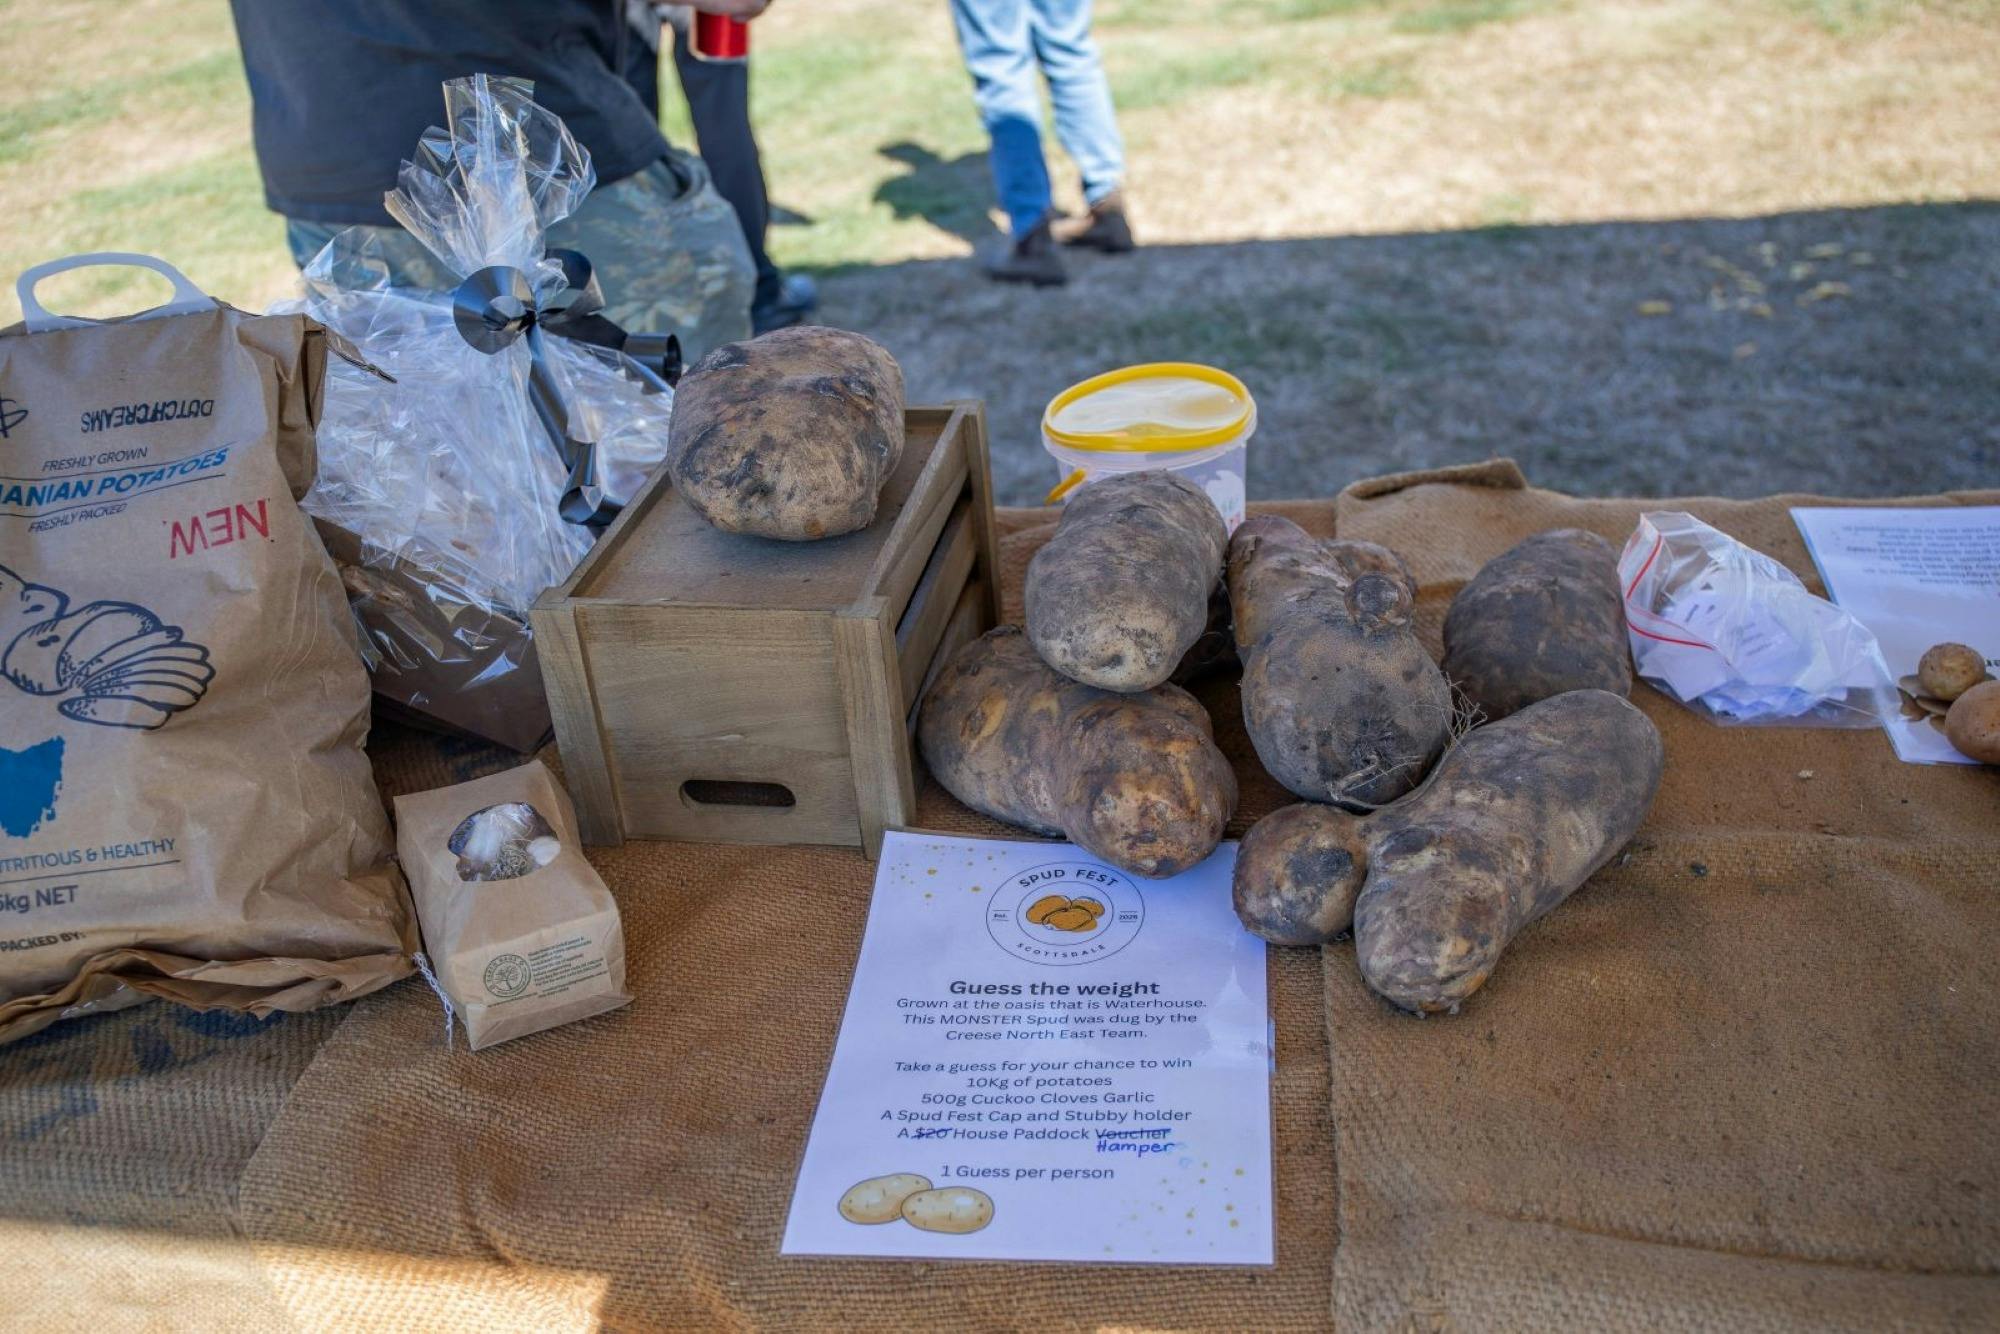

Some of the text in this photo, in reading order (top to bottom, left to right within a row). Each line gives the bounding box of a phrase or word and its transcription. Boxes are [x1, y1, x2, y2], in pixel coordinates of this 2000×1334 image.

[80, 402, 153, 433] CREAMS
[42, 447, 148, 472] FRESHLY GROWN
[0, 448, 230, 507] ANIAN POTATOES
[28, 503, 128, 533] FRESHLY PACKED
[86, 849, 97, 862] &
[101, 837, 176, 861] HEALTHY
[1018, 869, 1119, 888] SPUD FEST
[36, 885, 78, 908] NET
[0, 931, 87, 952] PACKED BY:
[1016, 942, 1107, 958] SCOTTSDALE
[950, 980, 1161, 998] Guess the weight
[896, 998, 1208, 1010] Grown at the oasis that is Waterhouse.
[902, 1013, 1198, 1027] This MONSTER Spud was dug by the
[945, 1028, 1149, 1041] Creese North East Team.
[895, 1057, 1193, 1075] Take a guess for your chance to win
[966, 1076, 1113, 1091] 10Kg of potatoes
[921, 1091, 1156, 1107] 500g Cuckoo Cloves Garlic
[880, 1109, 1193, 1124] A Spud Fest Cap and Stubby holder
[896, 1126, 1171, 1140] A $20 House Paddock Voucher
[1096, 1139, 1176, 1158] Hamper
[940, 1164, 1115, 1182] 1 Guess per person
